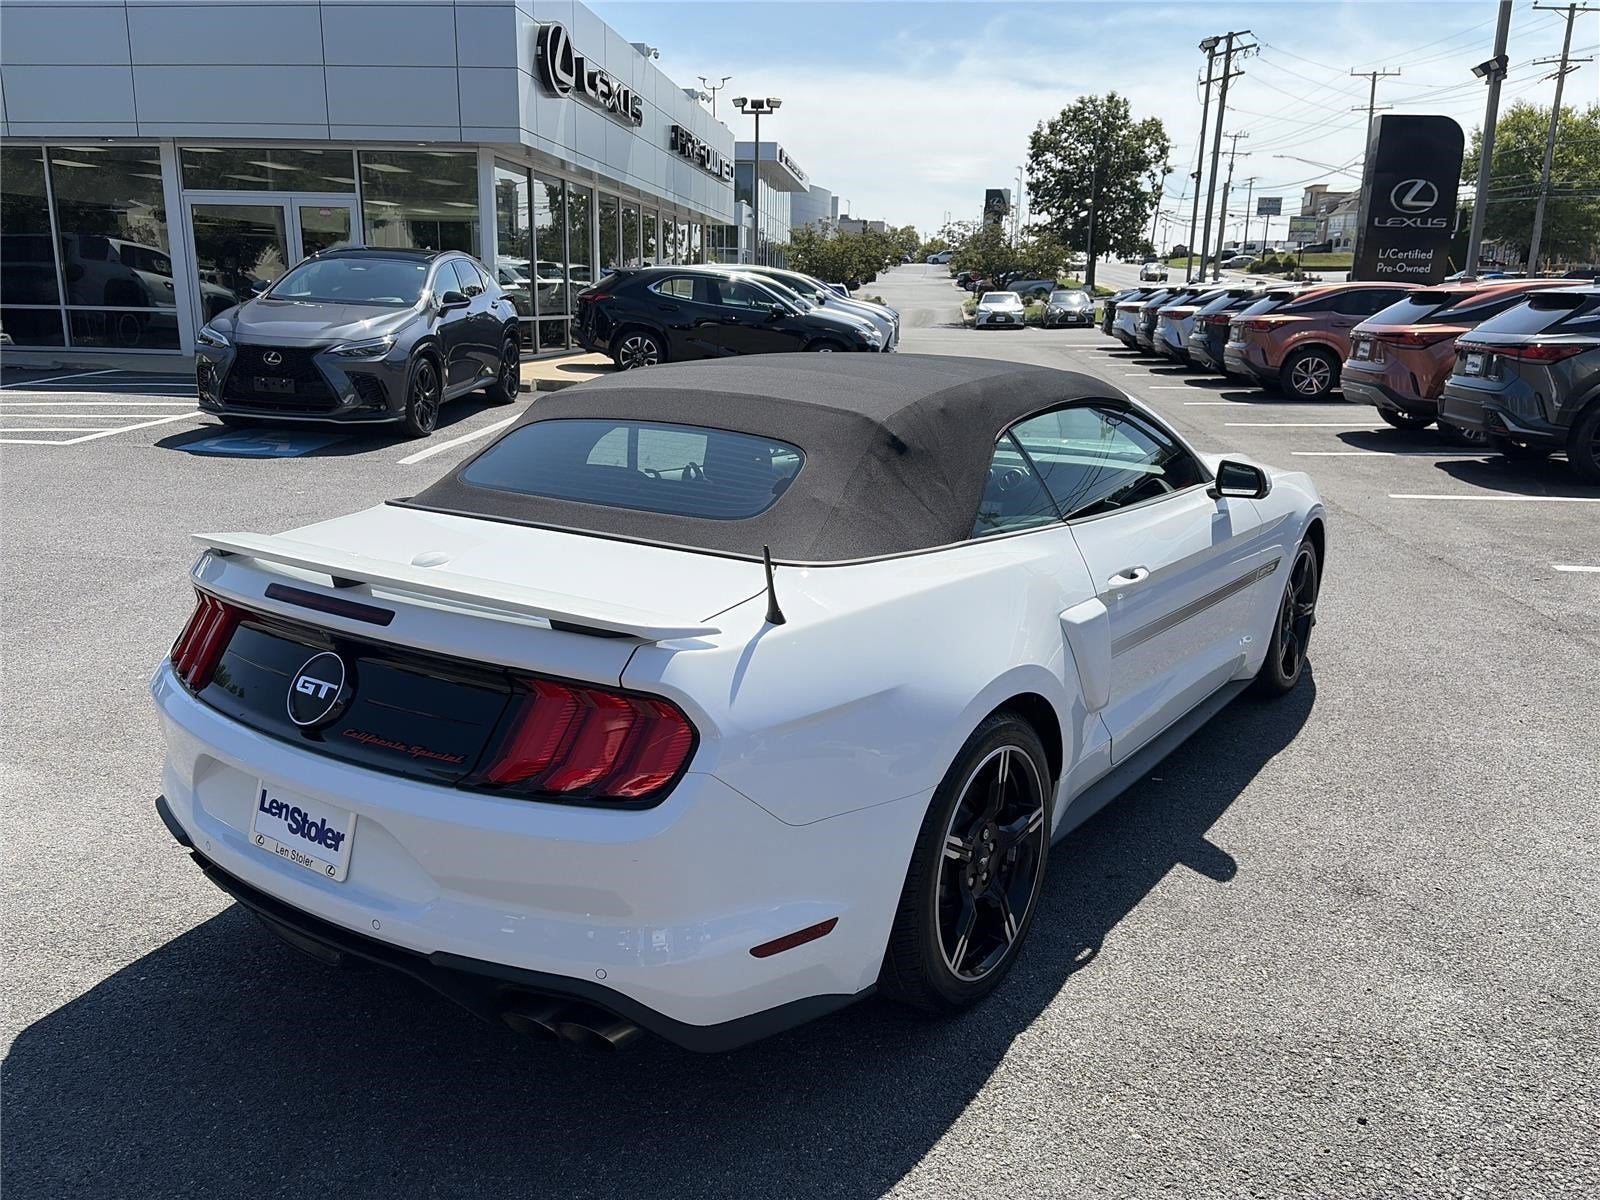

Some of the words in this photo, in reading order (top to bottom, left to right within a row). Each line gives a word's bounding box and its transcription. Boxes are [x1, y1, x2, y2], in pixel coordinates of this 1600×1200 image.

[574, 56, 643, 127] LEXUS
[1374, 217, 1447, 228] LEXUS
[1378, 249, 1434, 260] L/Certified
[1376, 263, 1431, 273] Pre-Owned
[296, 675, 339, 700] GT
[275, 842, 289, 857] Len
[290, 849, 313, 867] Stoler
